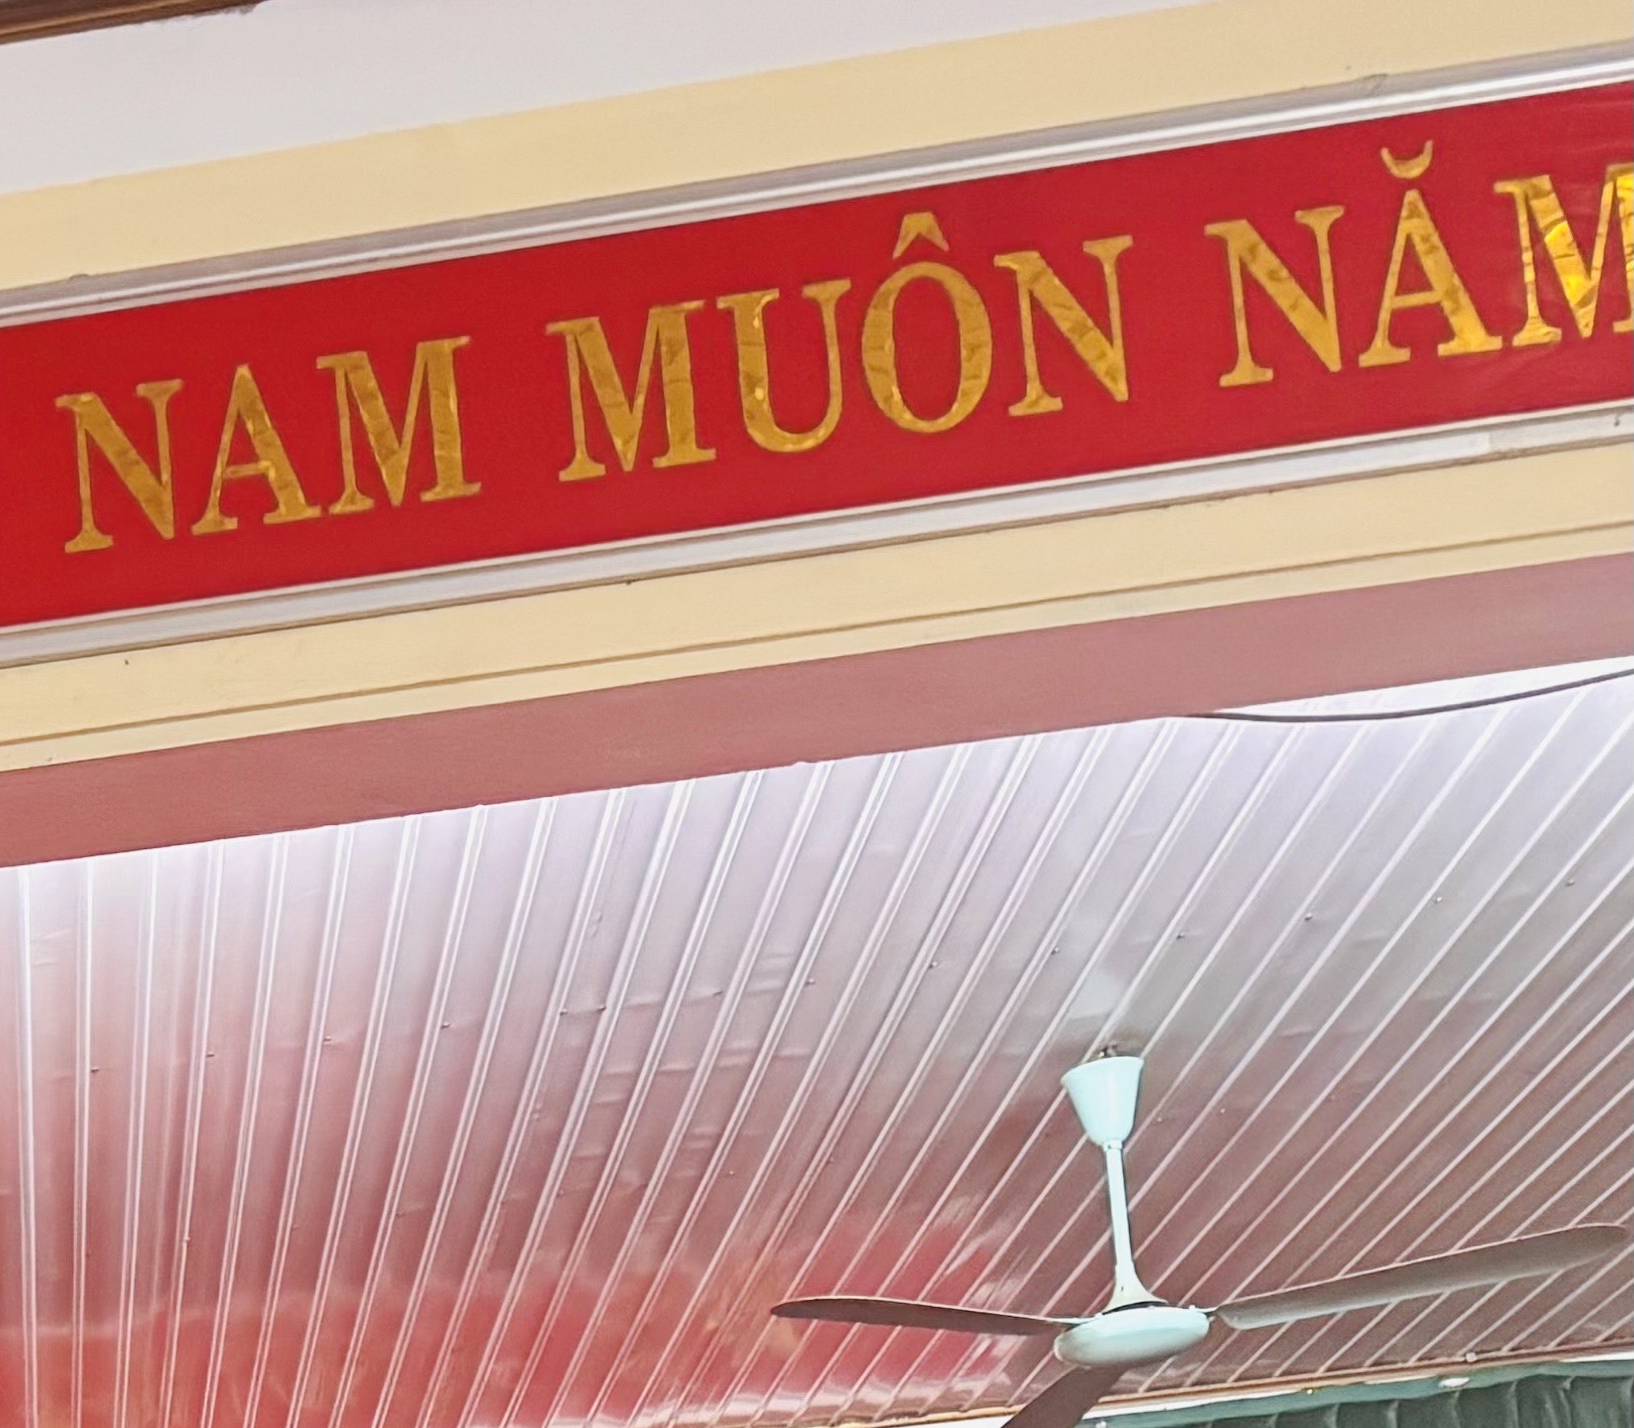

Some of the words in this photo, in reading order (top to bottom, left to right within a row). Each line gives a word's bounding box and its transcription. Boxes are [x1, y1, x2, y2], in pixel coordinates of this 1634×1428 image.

[57, 336, 481, 553] NAM
[547, 210, 1133, 482] MUÔN
[1205, 138, 1634, 390] NĂM
